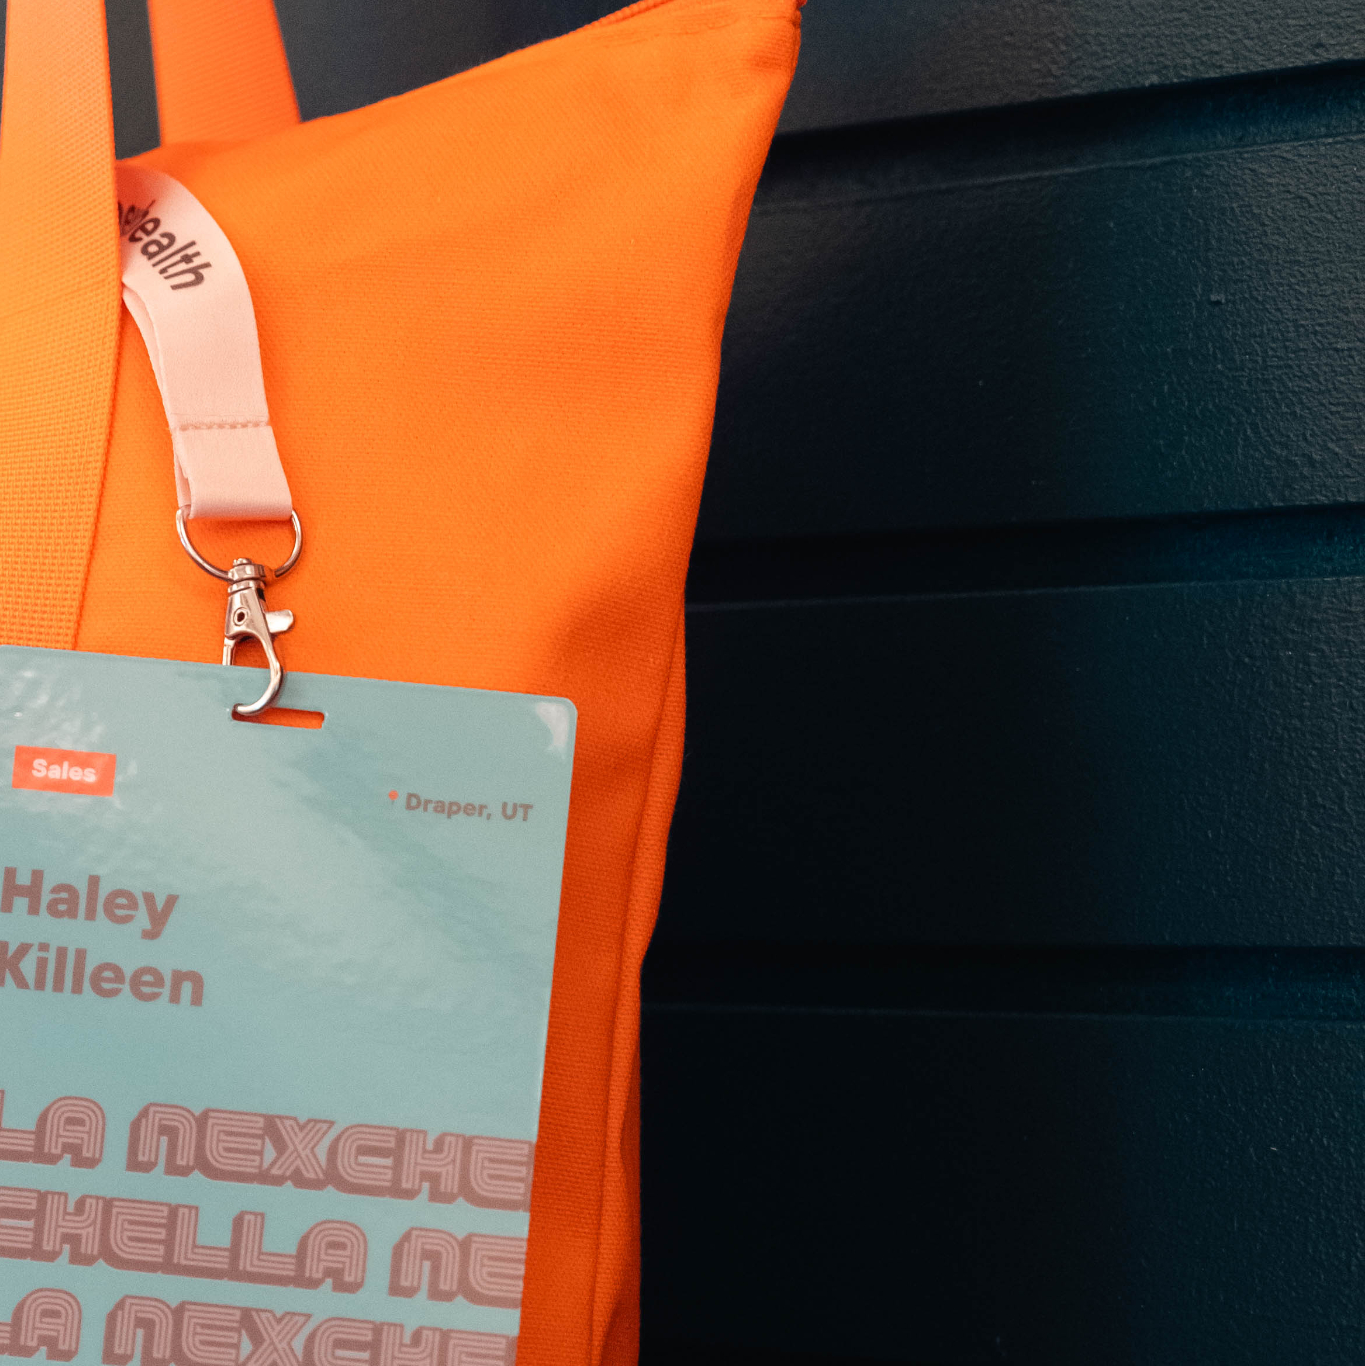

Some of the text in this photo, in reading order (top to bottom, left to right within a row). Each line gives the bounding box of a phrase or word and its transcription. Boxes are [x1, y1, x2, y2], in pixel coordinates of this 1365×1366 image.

[31, 758, 97, 784] Sales
[404, 792, 534, 823] Draper, UT
[0, 867, 180, 940] Haley
